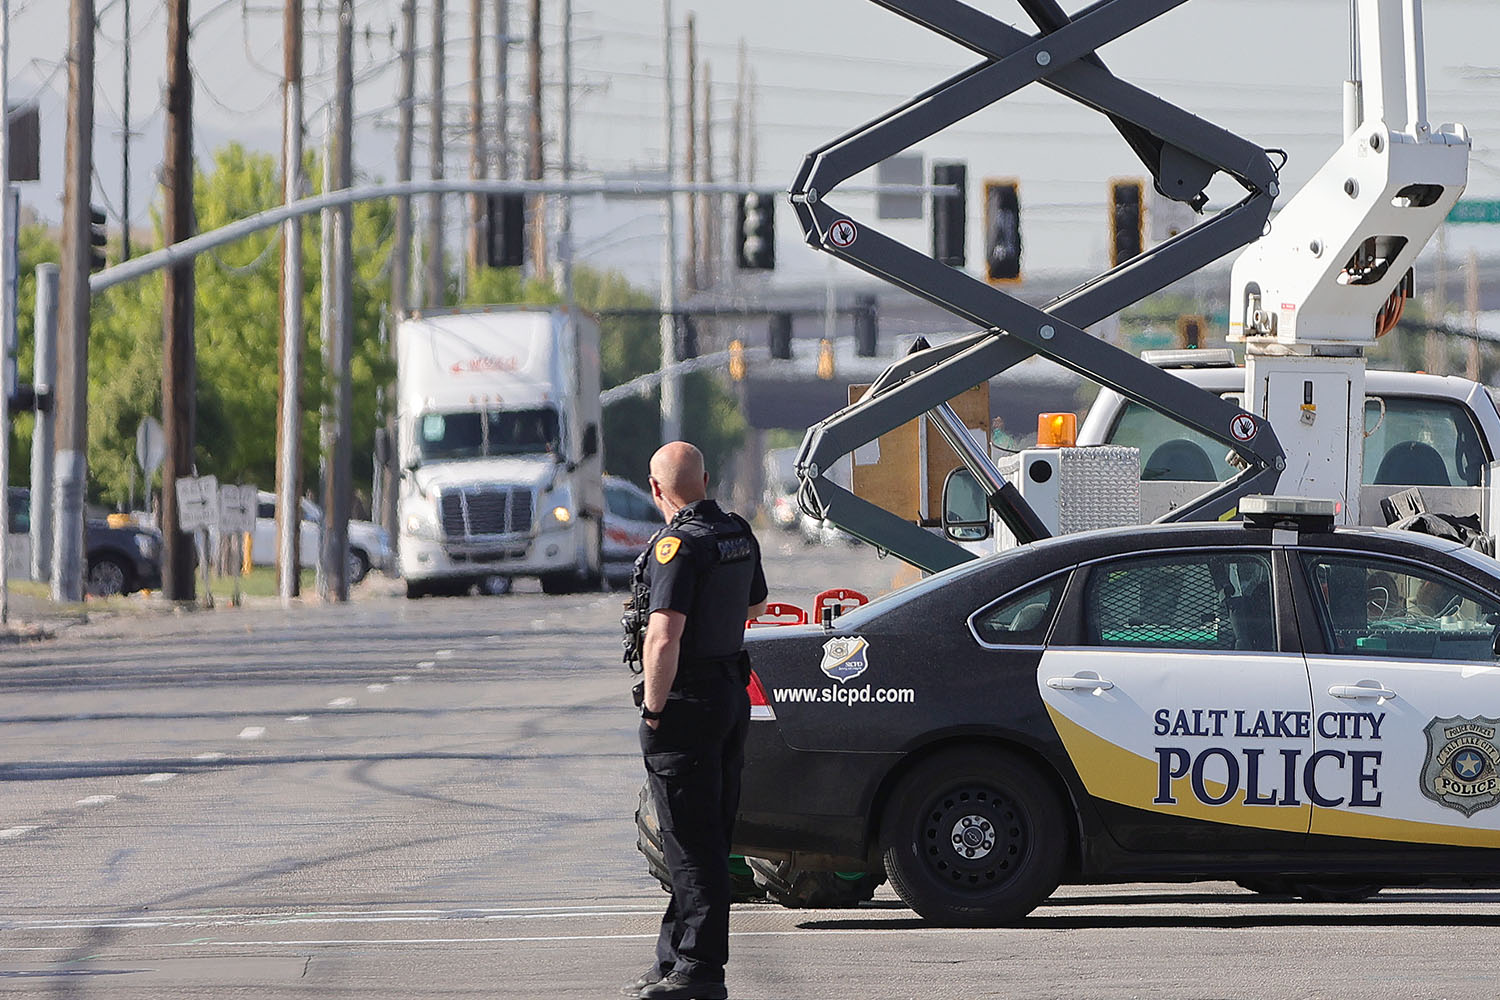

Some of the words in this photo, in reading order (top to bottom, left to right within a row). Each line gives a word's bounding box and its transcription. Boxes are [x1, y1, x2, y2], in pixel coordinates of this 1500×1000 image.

[773, 684, 915, 707] www.slcpd.com
[1153, 708, 1228, 737] SALT
[1234, 709, 1311, 738] LAKE
[1316, 711, 1386, 740] CITY
[1443, 738, 1461, 755] SALT
[1480, 738, 1496, 755] CITY
[1152, 747, 1383, 808] POLICE
[1442, 778, 1497, 795] POLICE
